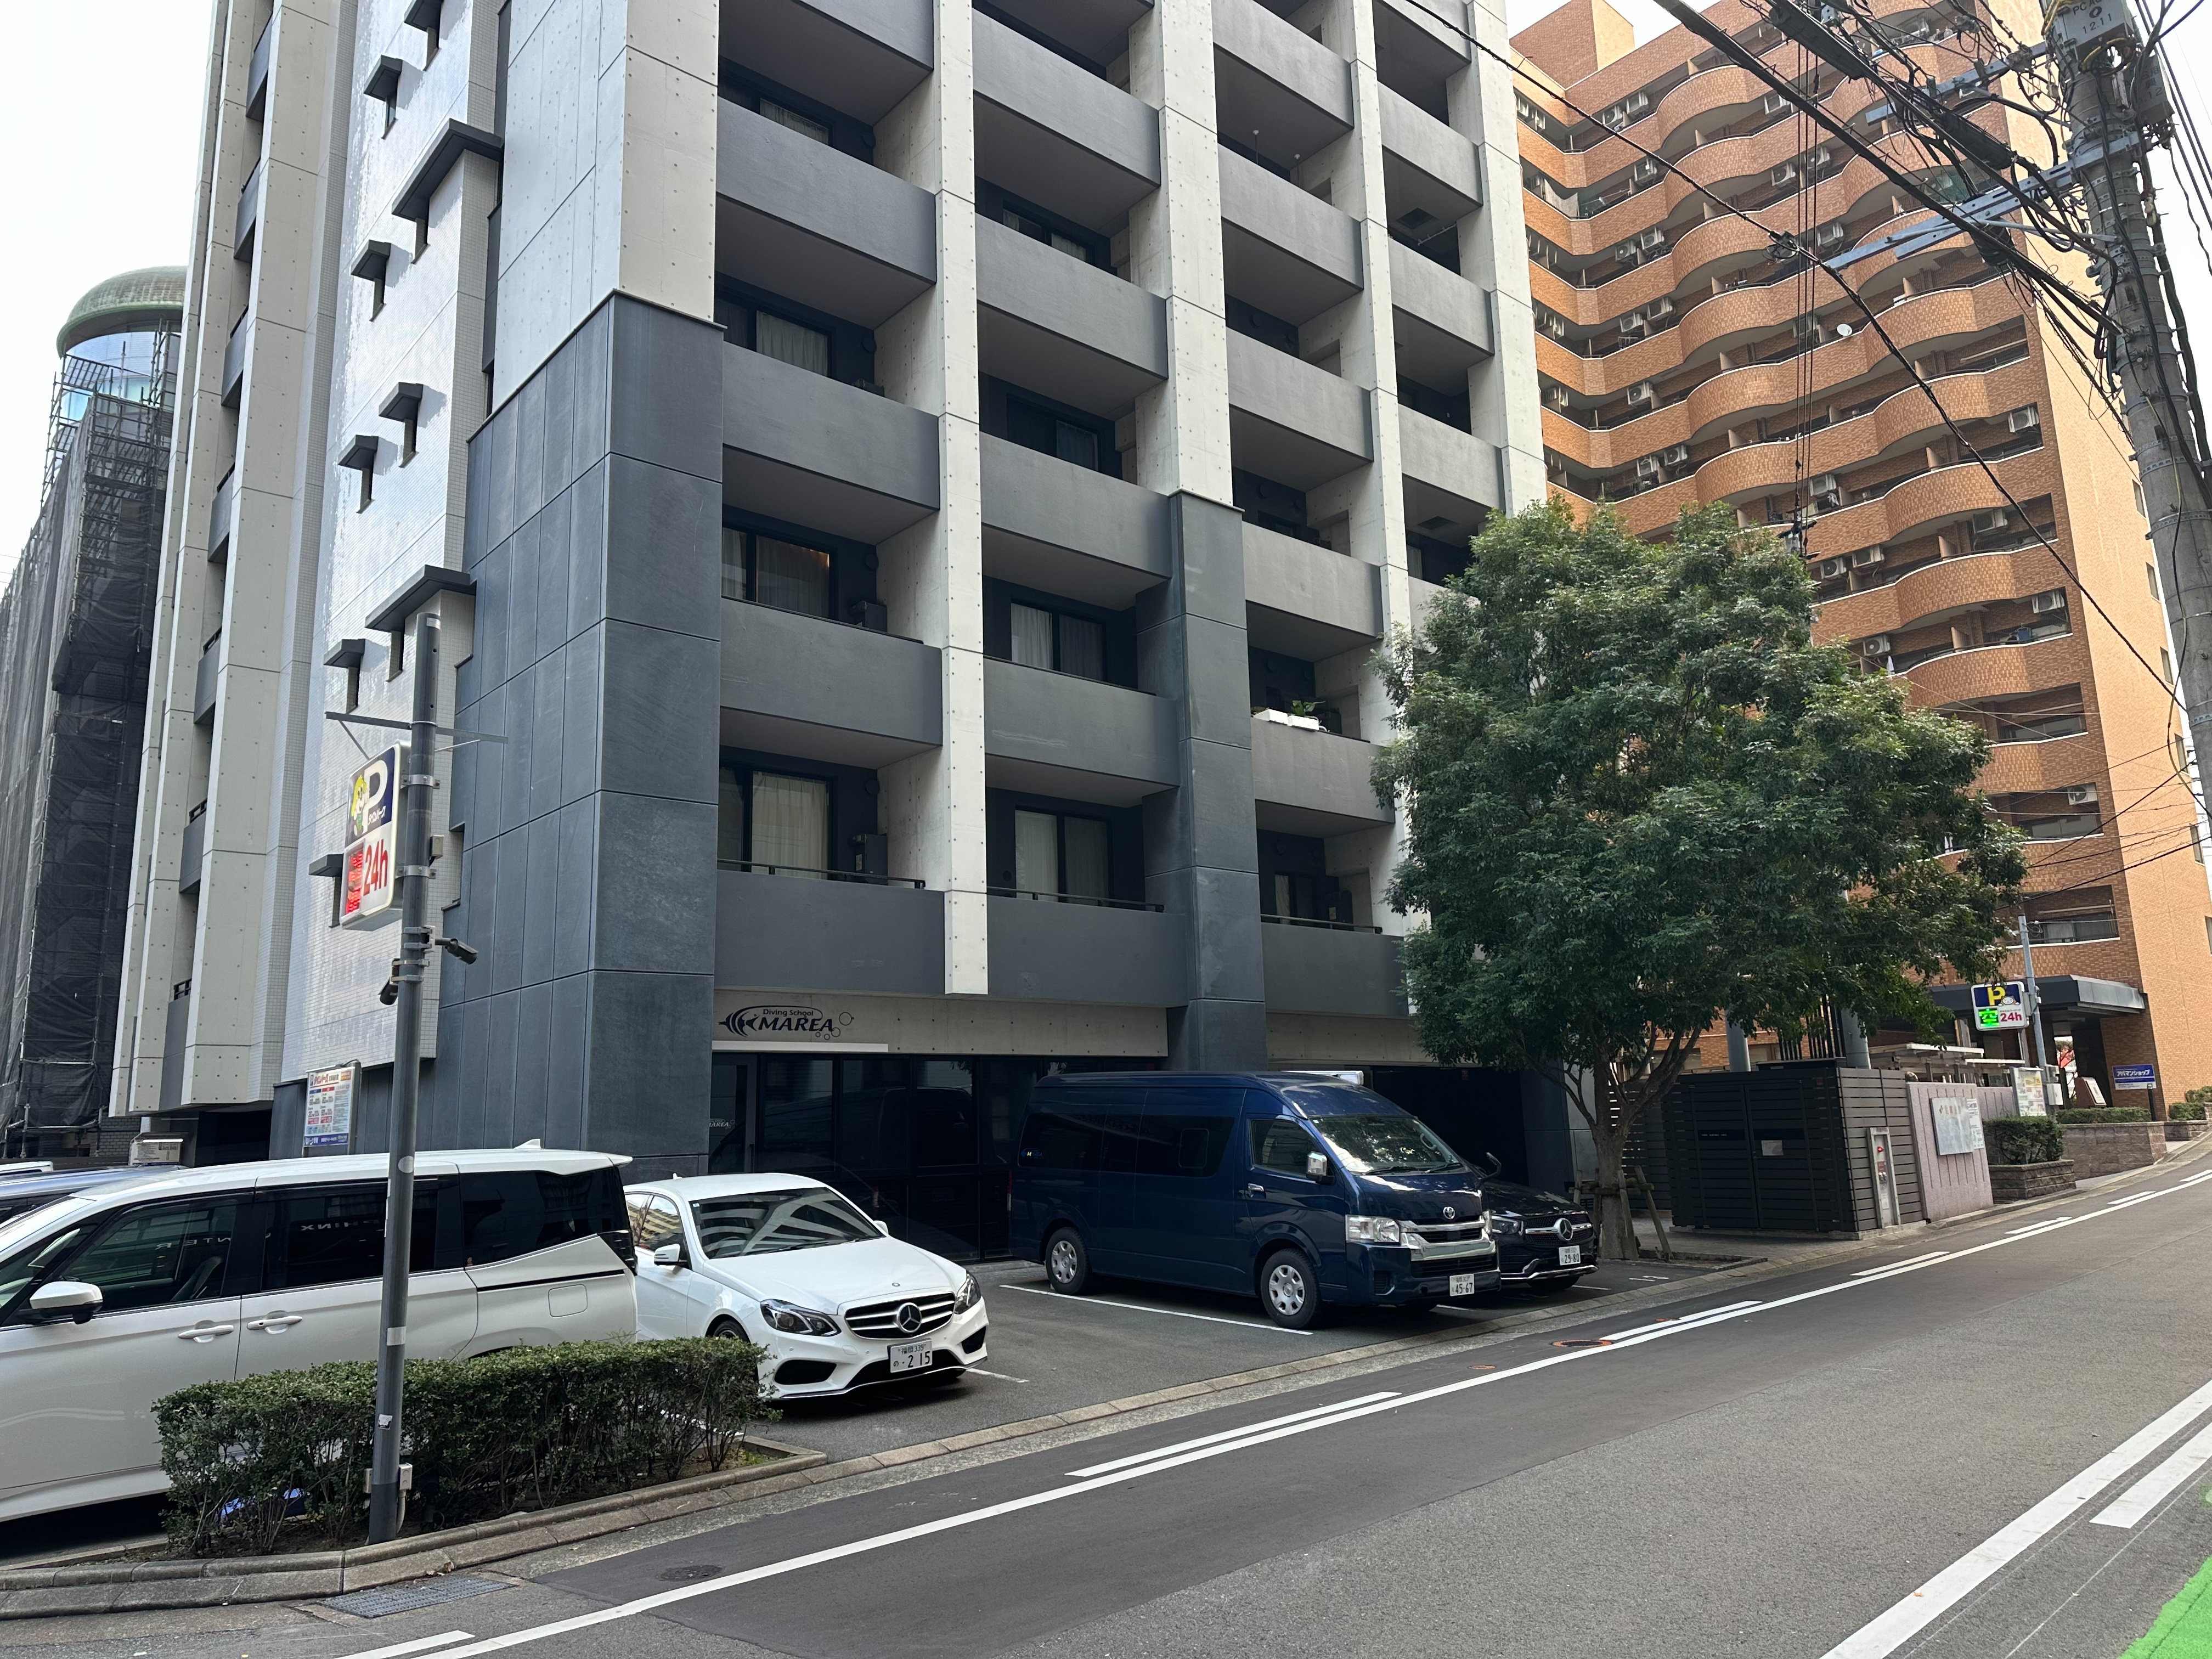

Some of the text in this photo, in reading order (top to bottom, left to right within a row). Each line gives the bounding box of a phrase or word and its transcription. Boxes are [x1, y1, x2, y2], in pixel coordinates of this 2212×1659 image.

[2073, 2, 2087, 15] PC
[362, 760, 388, 835] P
[363, 838, 388, 897] 24h
[1987, 986, 2006, 1006] P
[763, 1008, 787, 1017] Diving
[1978, 1008, 2000, 1027] 空
[2000, 1012, 2022, 1022] 24h
[758, 1017, 834, 1032] MAREA
[1565, 1253, 1579, 1263] 29-80
[1455, 1282, 1473, 1294] 45-67
[901, 1344, 924, 1355] 福岡 339
